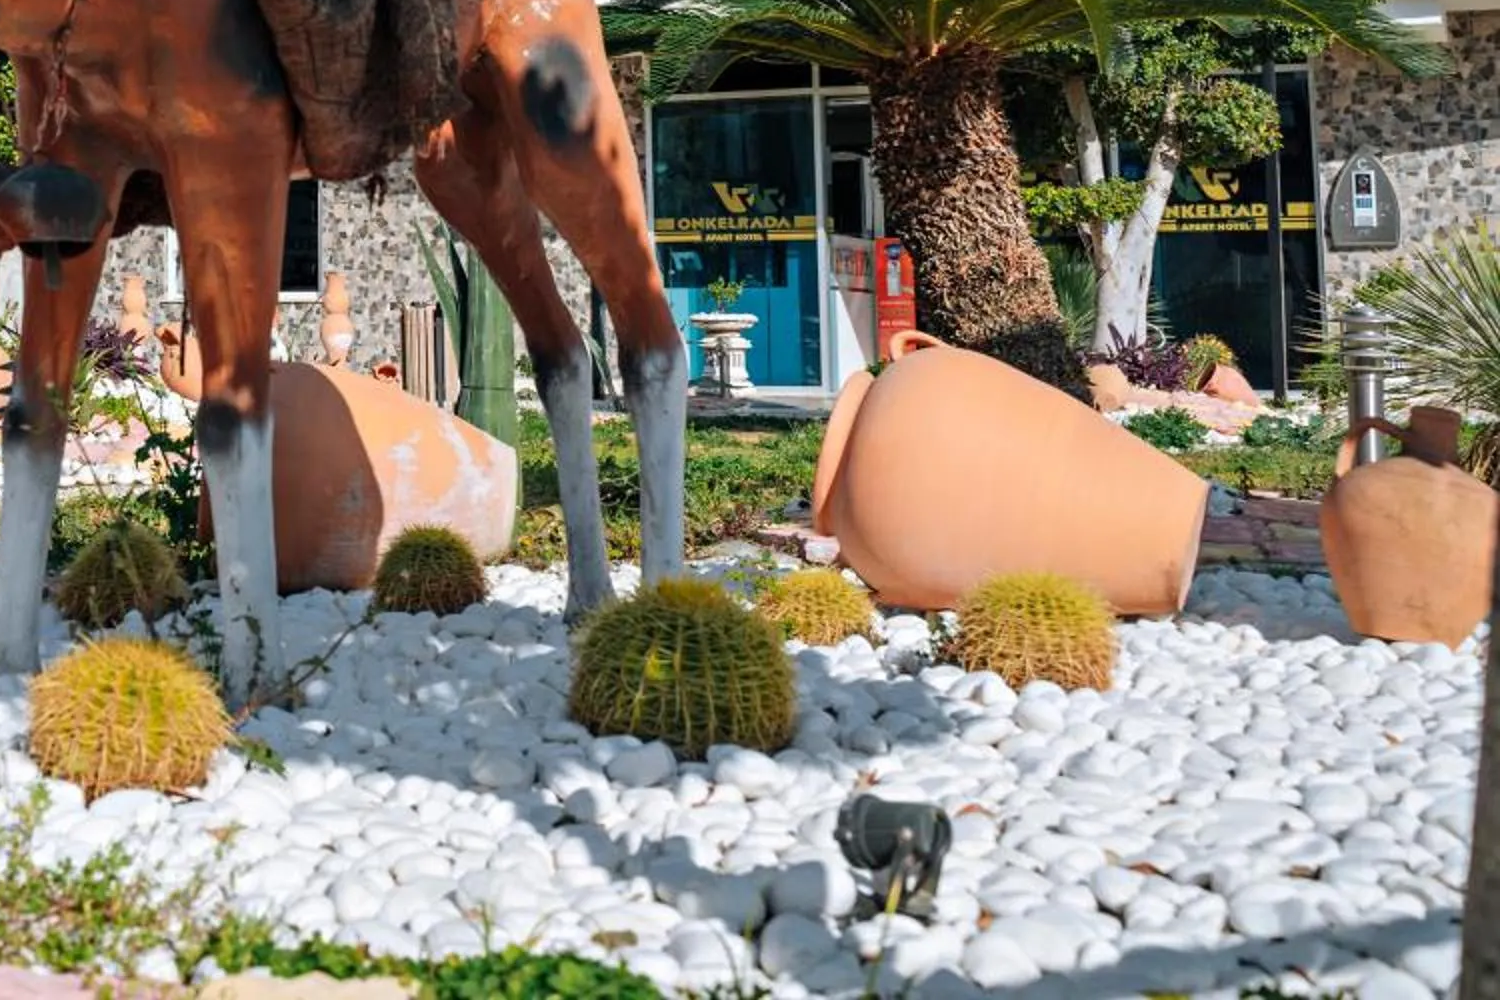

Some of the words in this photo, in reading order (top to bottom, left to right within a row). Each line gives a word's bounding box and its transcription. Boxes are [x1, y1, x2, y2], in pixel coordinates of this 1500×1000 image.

[1164, 203, 1283, 218] NKELRAD
[678, 217, 790, 230] ONKELRADA
[1181, 223, 1215, 231] APART
